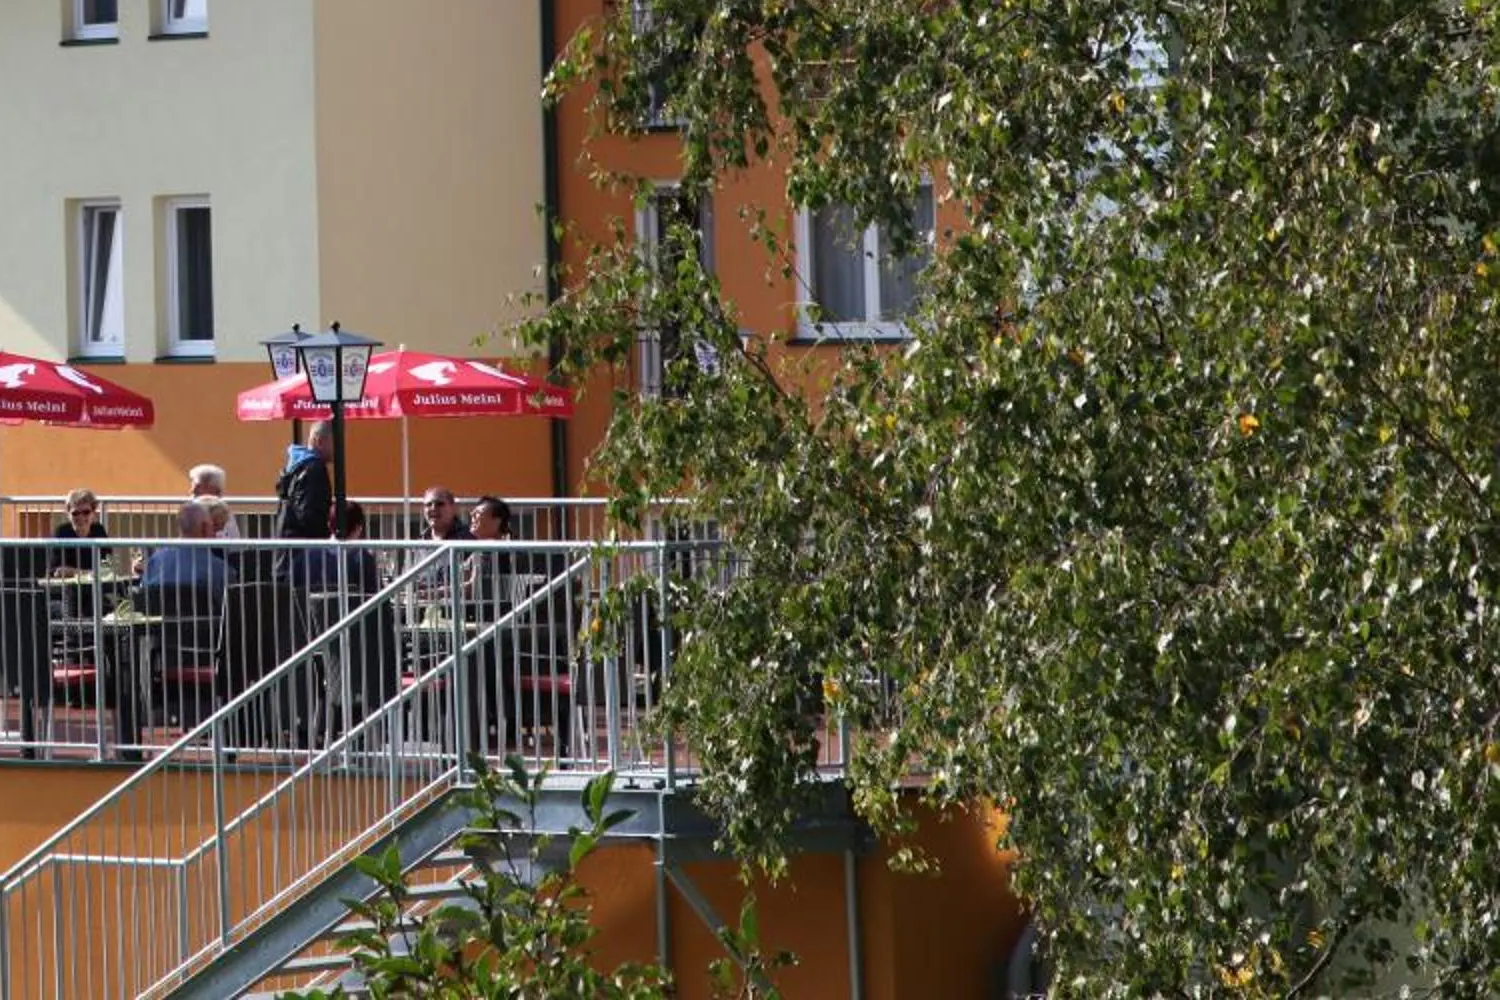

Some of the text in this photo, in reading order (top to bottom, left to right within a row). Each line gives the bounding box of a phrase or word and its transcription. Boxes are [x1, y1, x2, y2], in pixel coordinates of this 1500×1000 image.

[413, 394, 501, 405] Julius Meinl
[27, 400, 67, 413] Meinl
